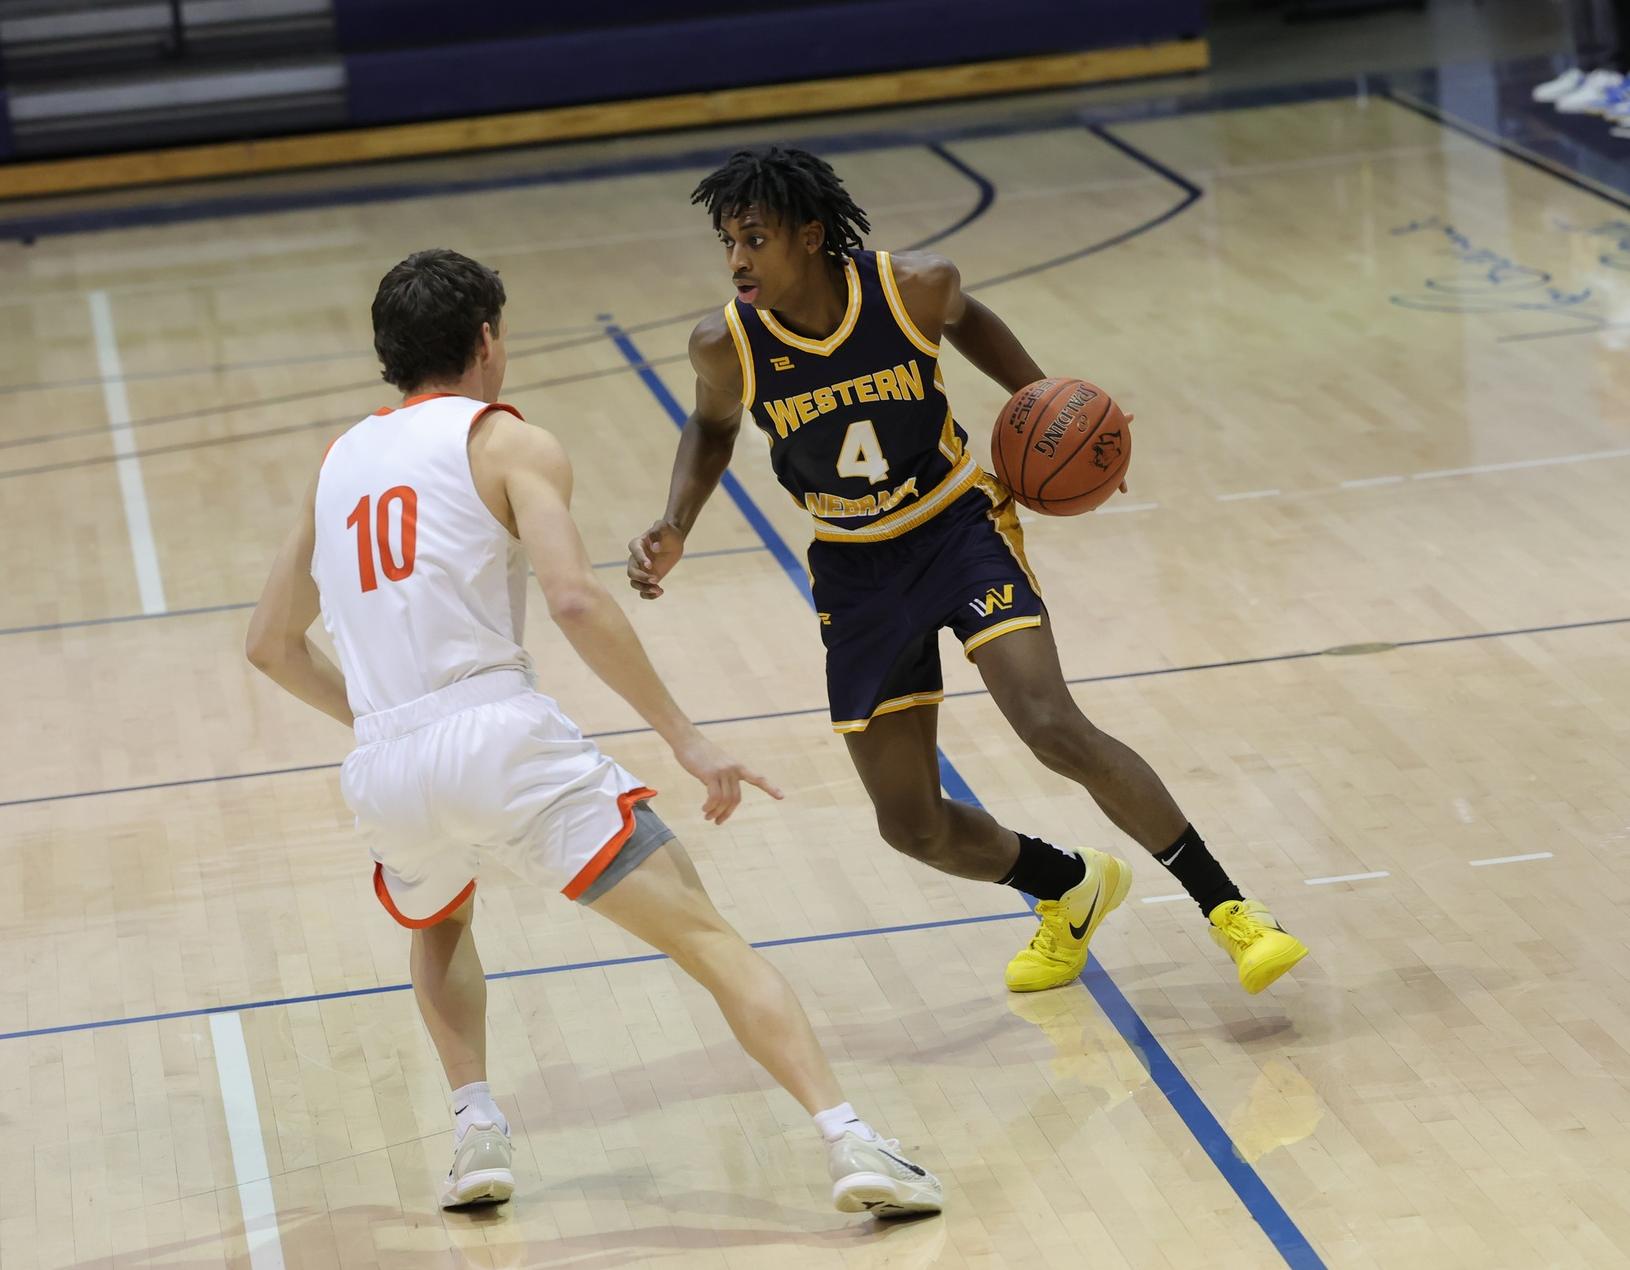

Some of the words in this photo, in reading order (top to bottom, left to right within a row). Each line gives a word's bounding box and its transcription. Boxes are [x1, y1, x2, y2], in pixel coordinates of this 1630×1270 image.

[764, 359, 925, 439] WESTERN
[1034, 383, 1098, 459] SPALDING
[836, 419, 890, 486] 4
[346, 485, 418, 593] 10
